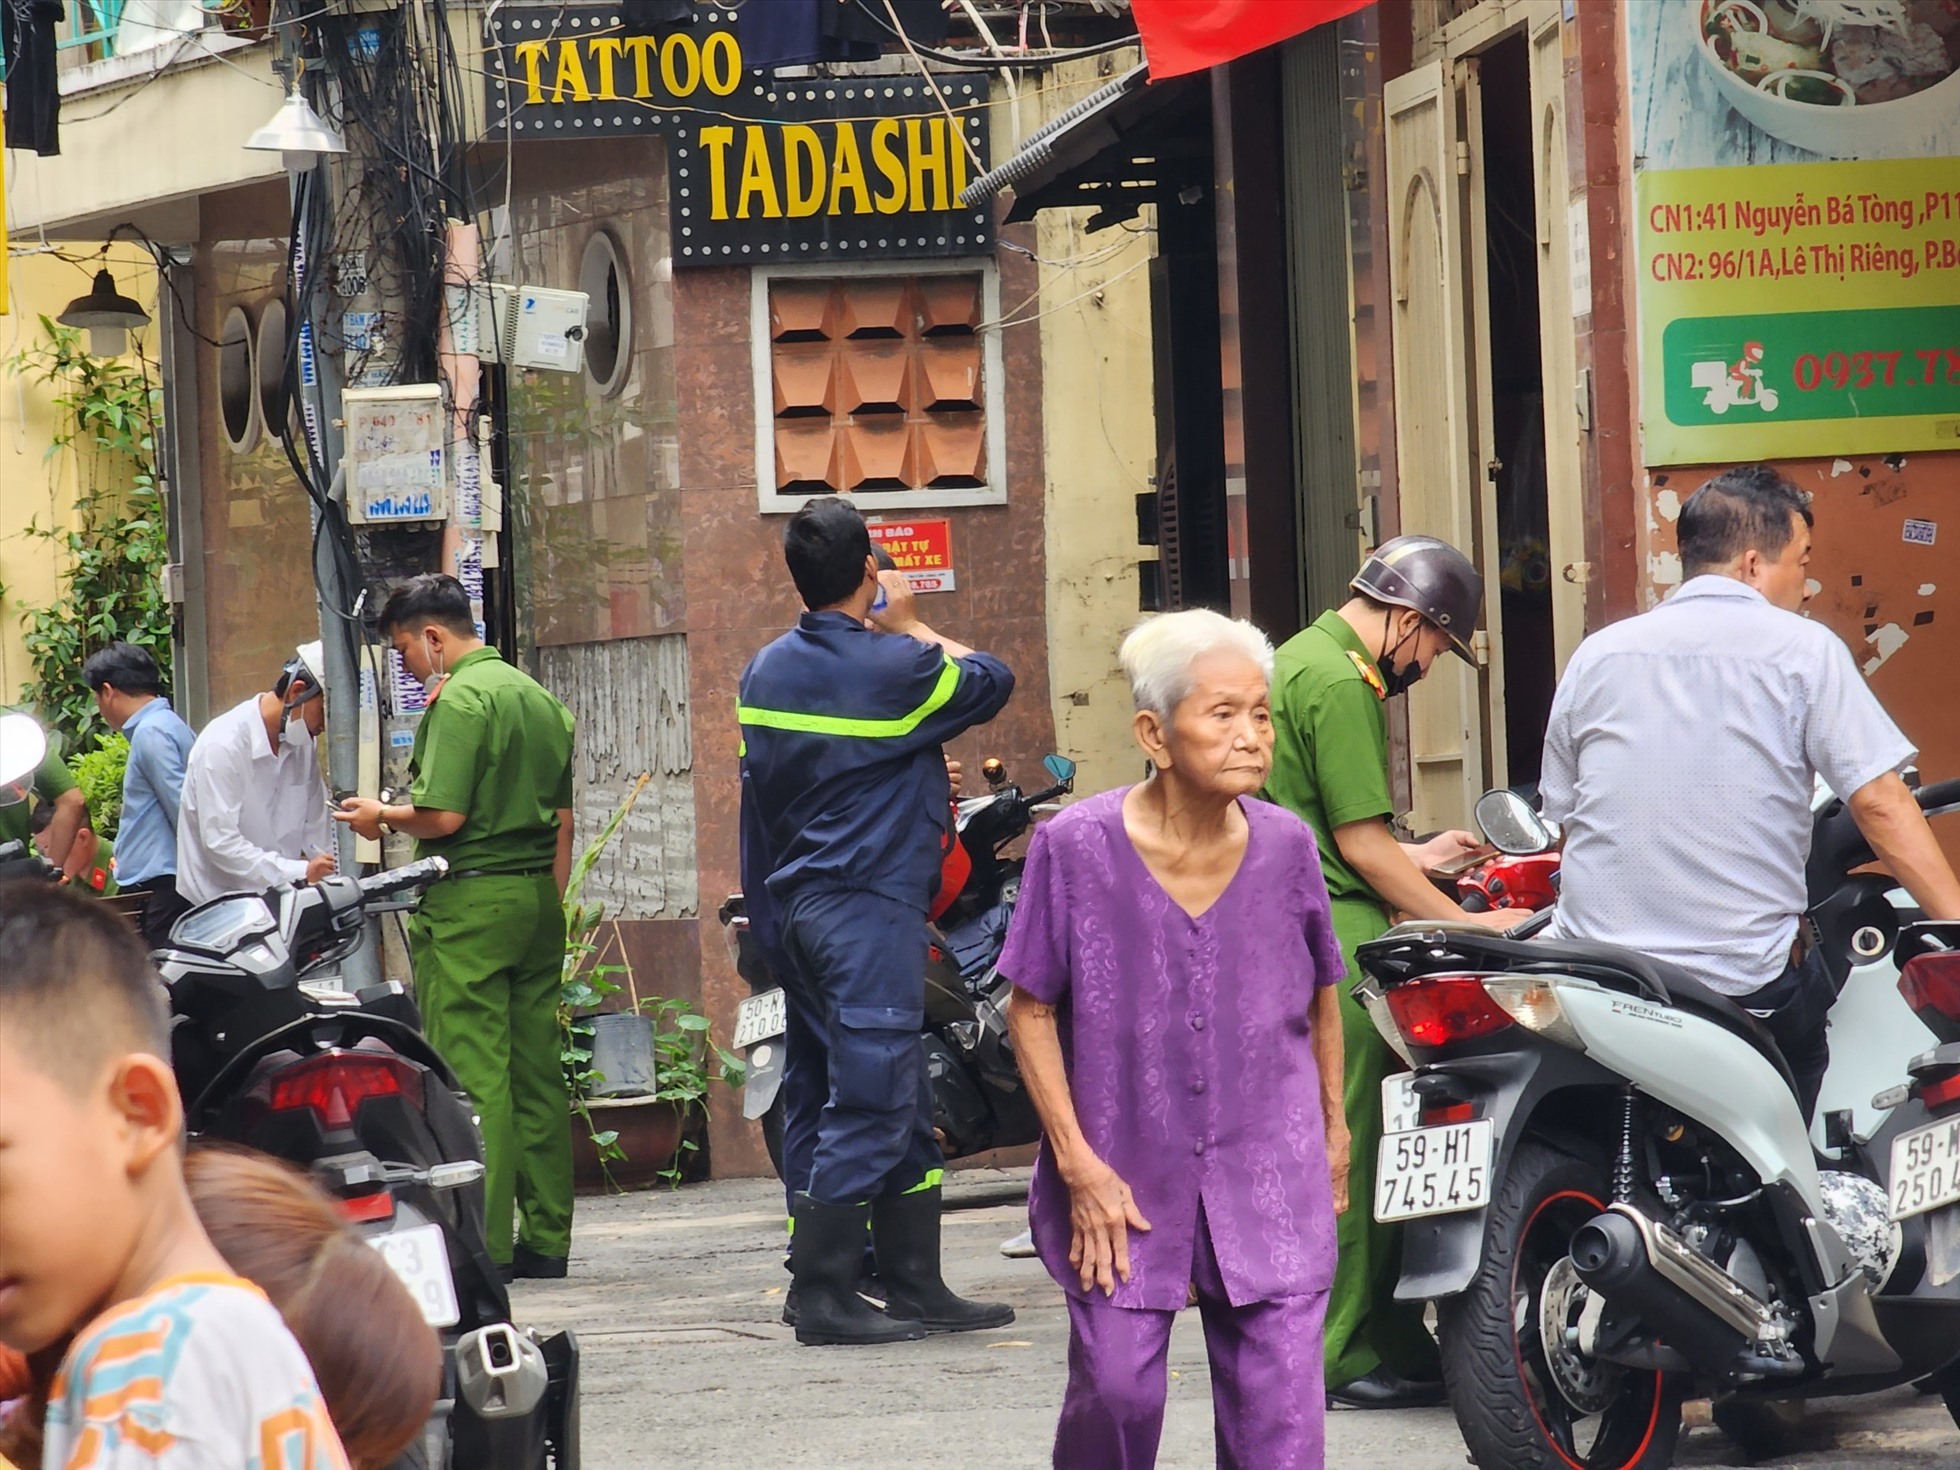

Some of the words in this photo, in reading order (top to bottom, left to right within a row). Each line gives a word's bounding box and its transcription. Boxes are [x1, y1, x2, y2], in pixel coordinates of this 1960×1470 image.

[515, 31, 742, 104] TATTOO
[699, 117, 967, 220] TADASHI
[1650, 202, 1727, 233] CN1:41
[1735, 192, 1821, 236] Nguyễn
[1827, 195, 1855, 225] Bá
[1858, 193, 1913, 230] Tòng
[1652, 252, 1704, 282] CN2:
[1810, 244, 1845, 281] Thị
[1850, 242, 1919, 278] Riêng,
[1925, 240, 1960, 269] P.B
[882, 540, 907, 554] RẬT
[911, 540, 930, 553] TỰ
[925, 555, 942, 565] XE
[1396, 1128, 1471, 1171] 59-H1
[1383, 1167, 1482, 1215] 745.45
